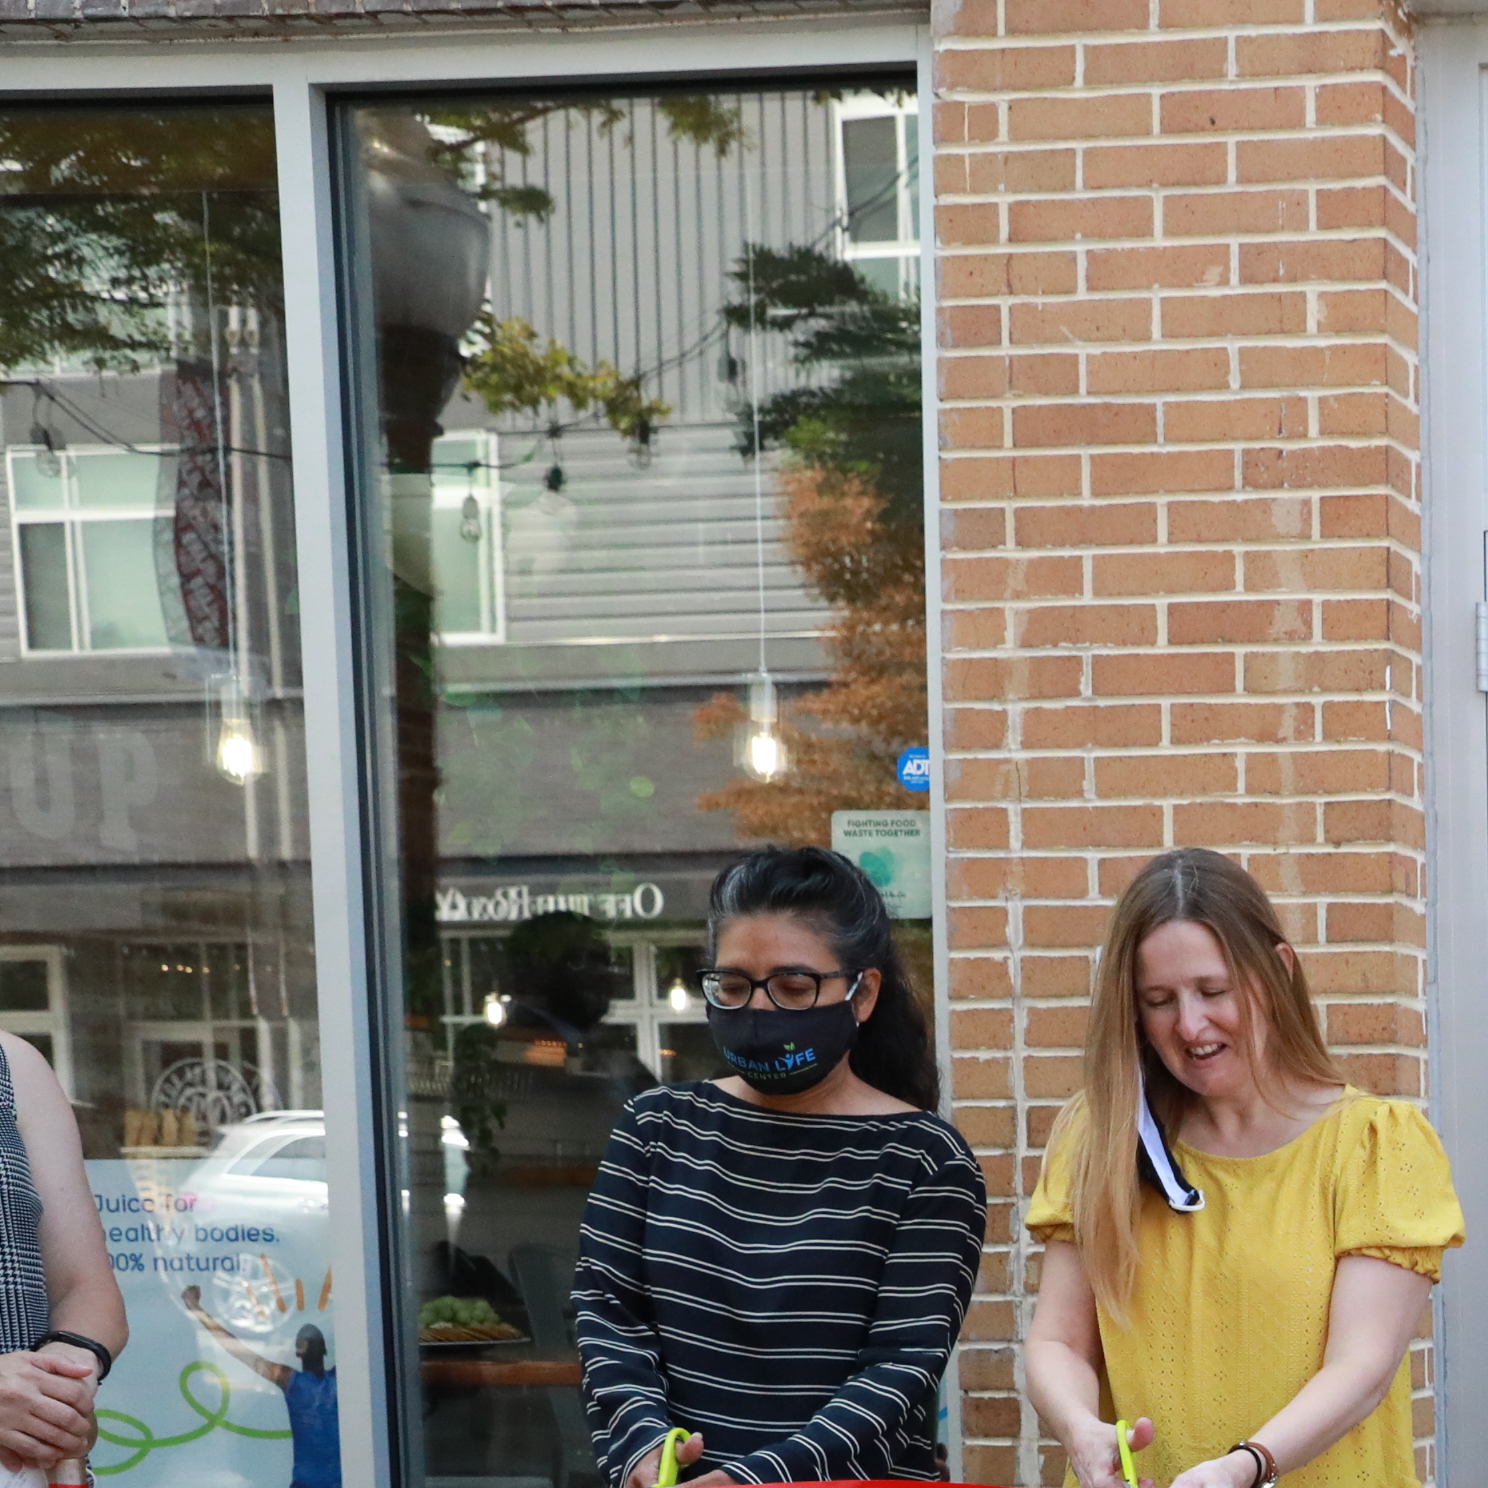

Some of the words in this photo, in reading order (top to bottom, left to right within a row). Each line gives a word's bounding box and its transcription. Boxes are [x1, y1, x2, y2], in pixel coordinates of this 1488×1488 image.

[902, 759, 930, 776] ADT
[847, 819, 889, 828] FIGHTING
[891, 819, 917, 828] FOOD
[843, 829, 873, 838] WASTE
[875, 829, 921, 838] TOGETHER
[723, 1046, 771, 1072] URBAN
[747, 1071, 787, 1080] CENTER
[95, 1194, 155, 1213] Juice
[165, 1193, 198, 1213] for
[103, 1223, 185, 1246] ealthy
[195, 1223, 280, 1243] bodies.
[153, 1252, 247, 1272] natural.
